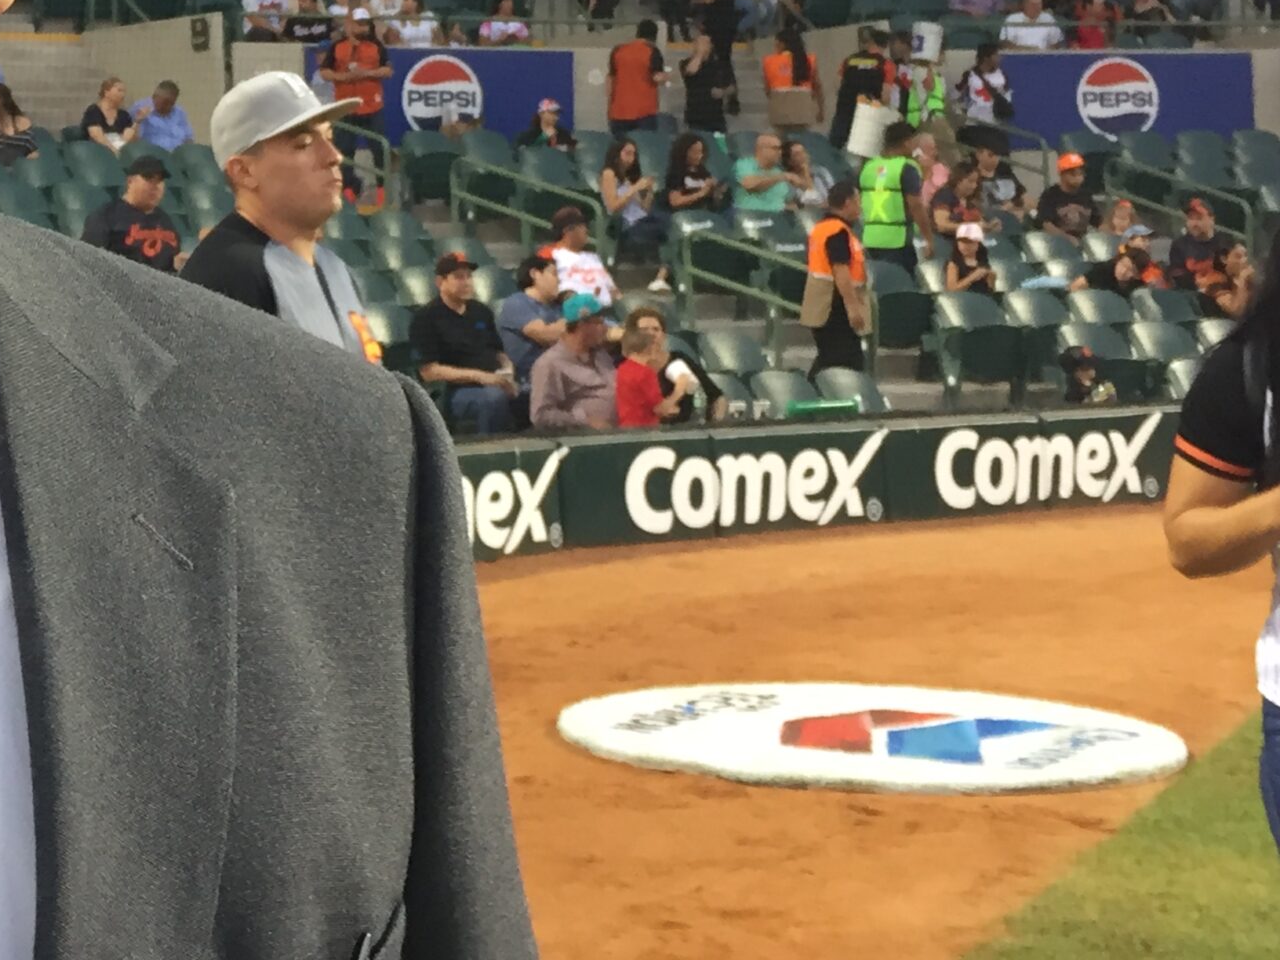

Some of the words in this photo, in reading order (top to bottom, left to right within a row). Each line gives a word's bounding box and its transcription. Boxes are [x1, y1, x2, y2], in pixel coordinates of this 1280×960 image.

[407, 90, 477, 108] PEPSI
[1081, 91, 1153, 108] PEPSI
[625, 427, 891, 535] Comex
[934, 410, 1163, 510] Comex
